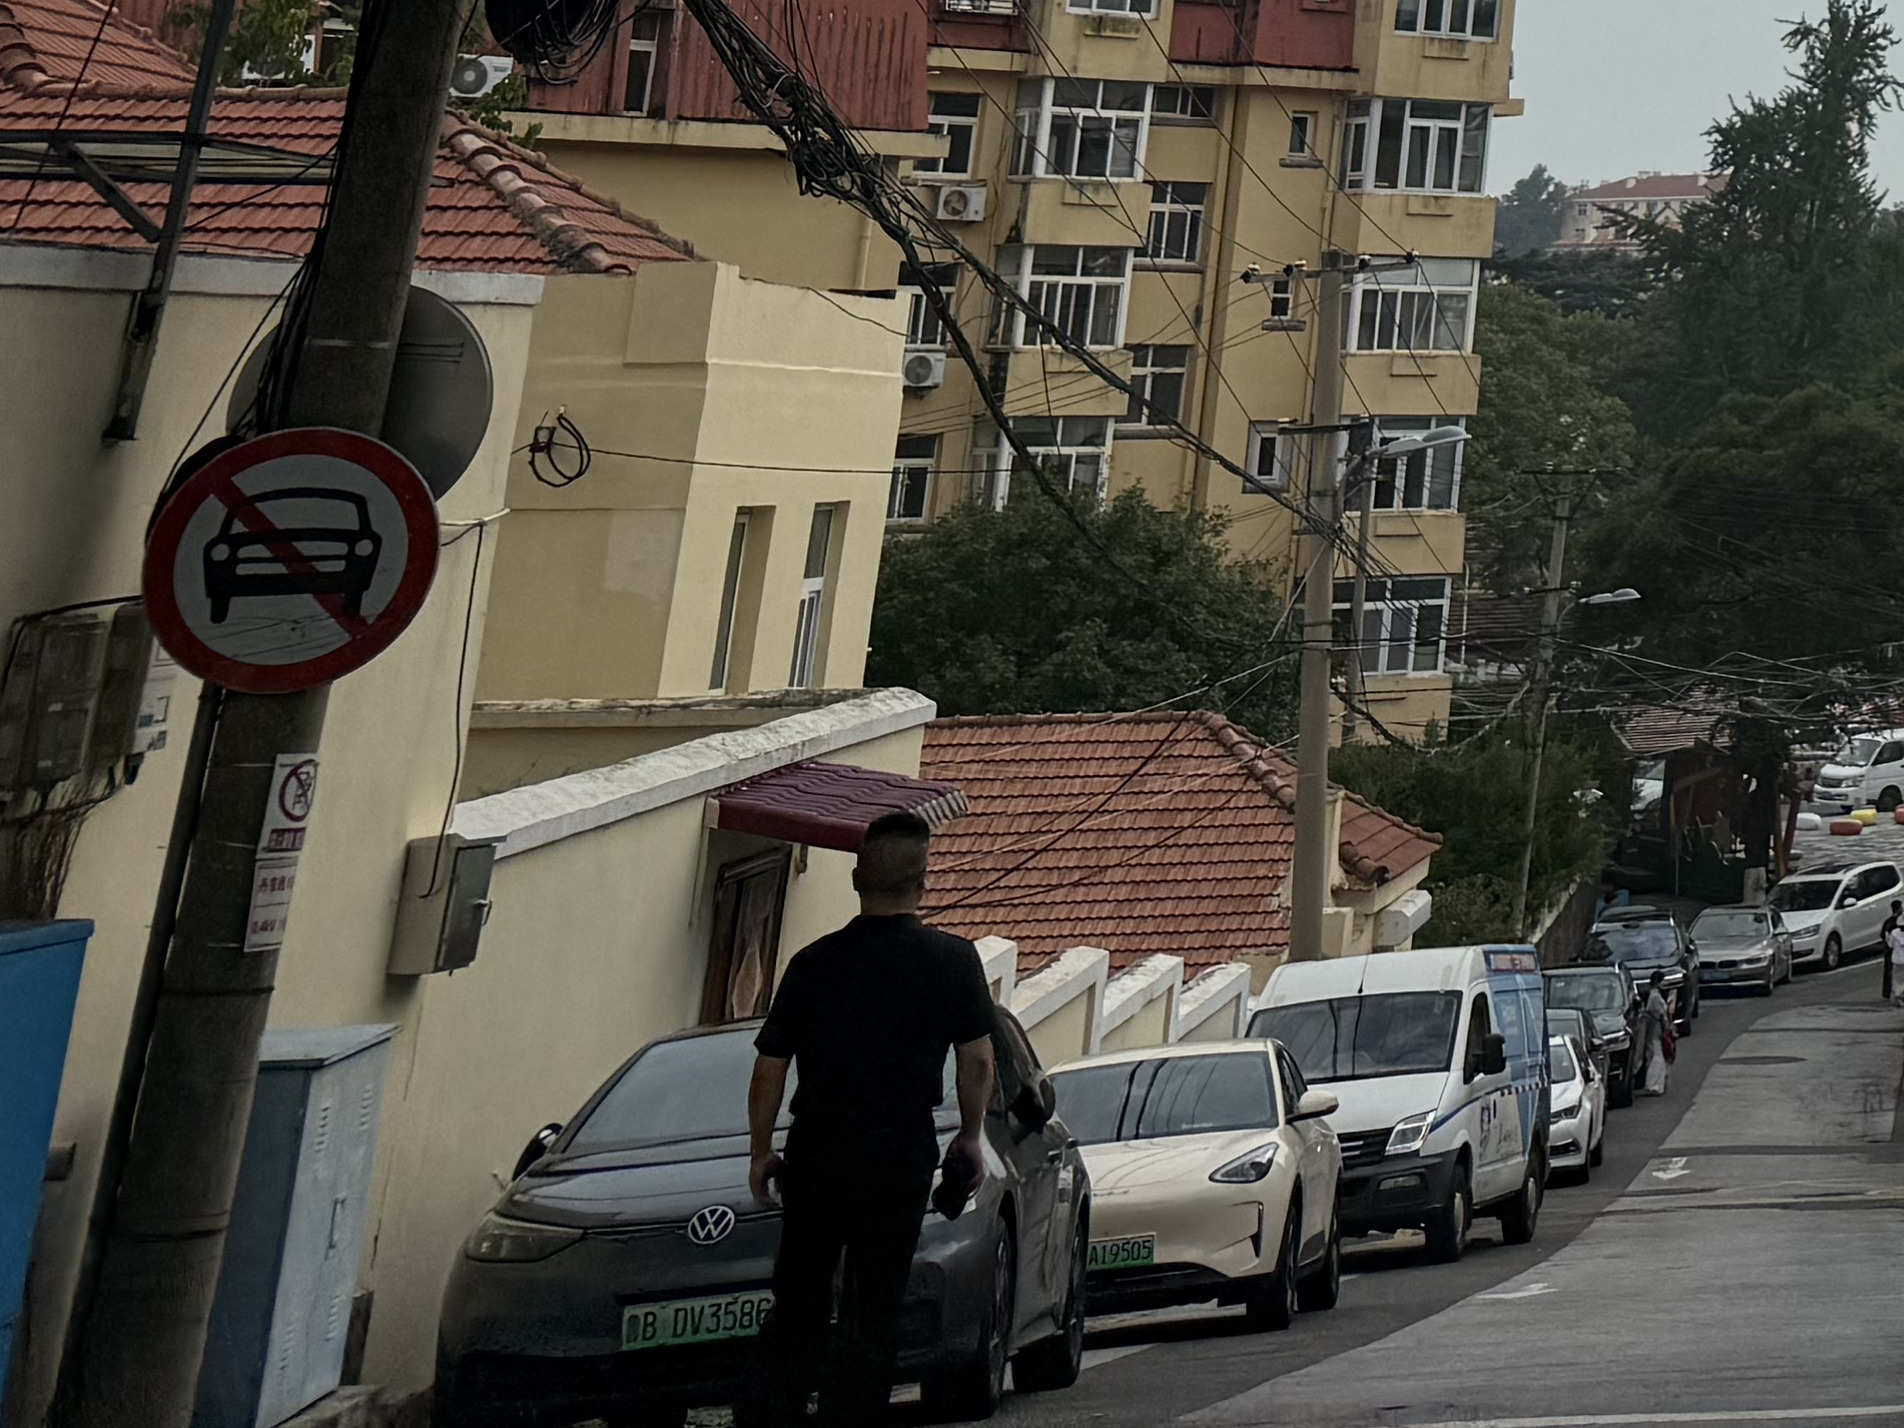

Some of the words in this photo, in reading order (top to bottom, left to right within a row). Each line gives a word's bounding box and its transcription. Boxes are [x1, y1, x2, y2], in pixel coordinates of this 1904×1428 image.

[1089, 1239, 1152, 1266] A19505
[626, 1311, 657, 1344] B
[672, 1297, 772, 1338] DV3586
